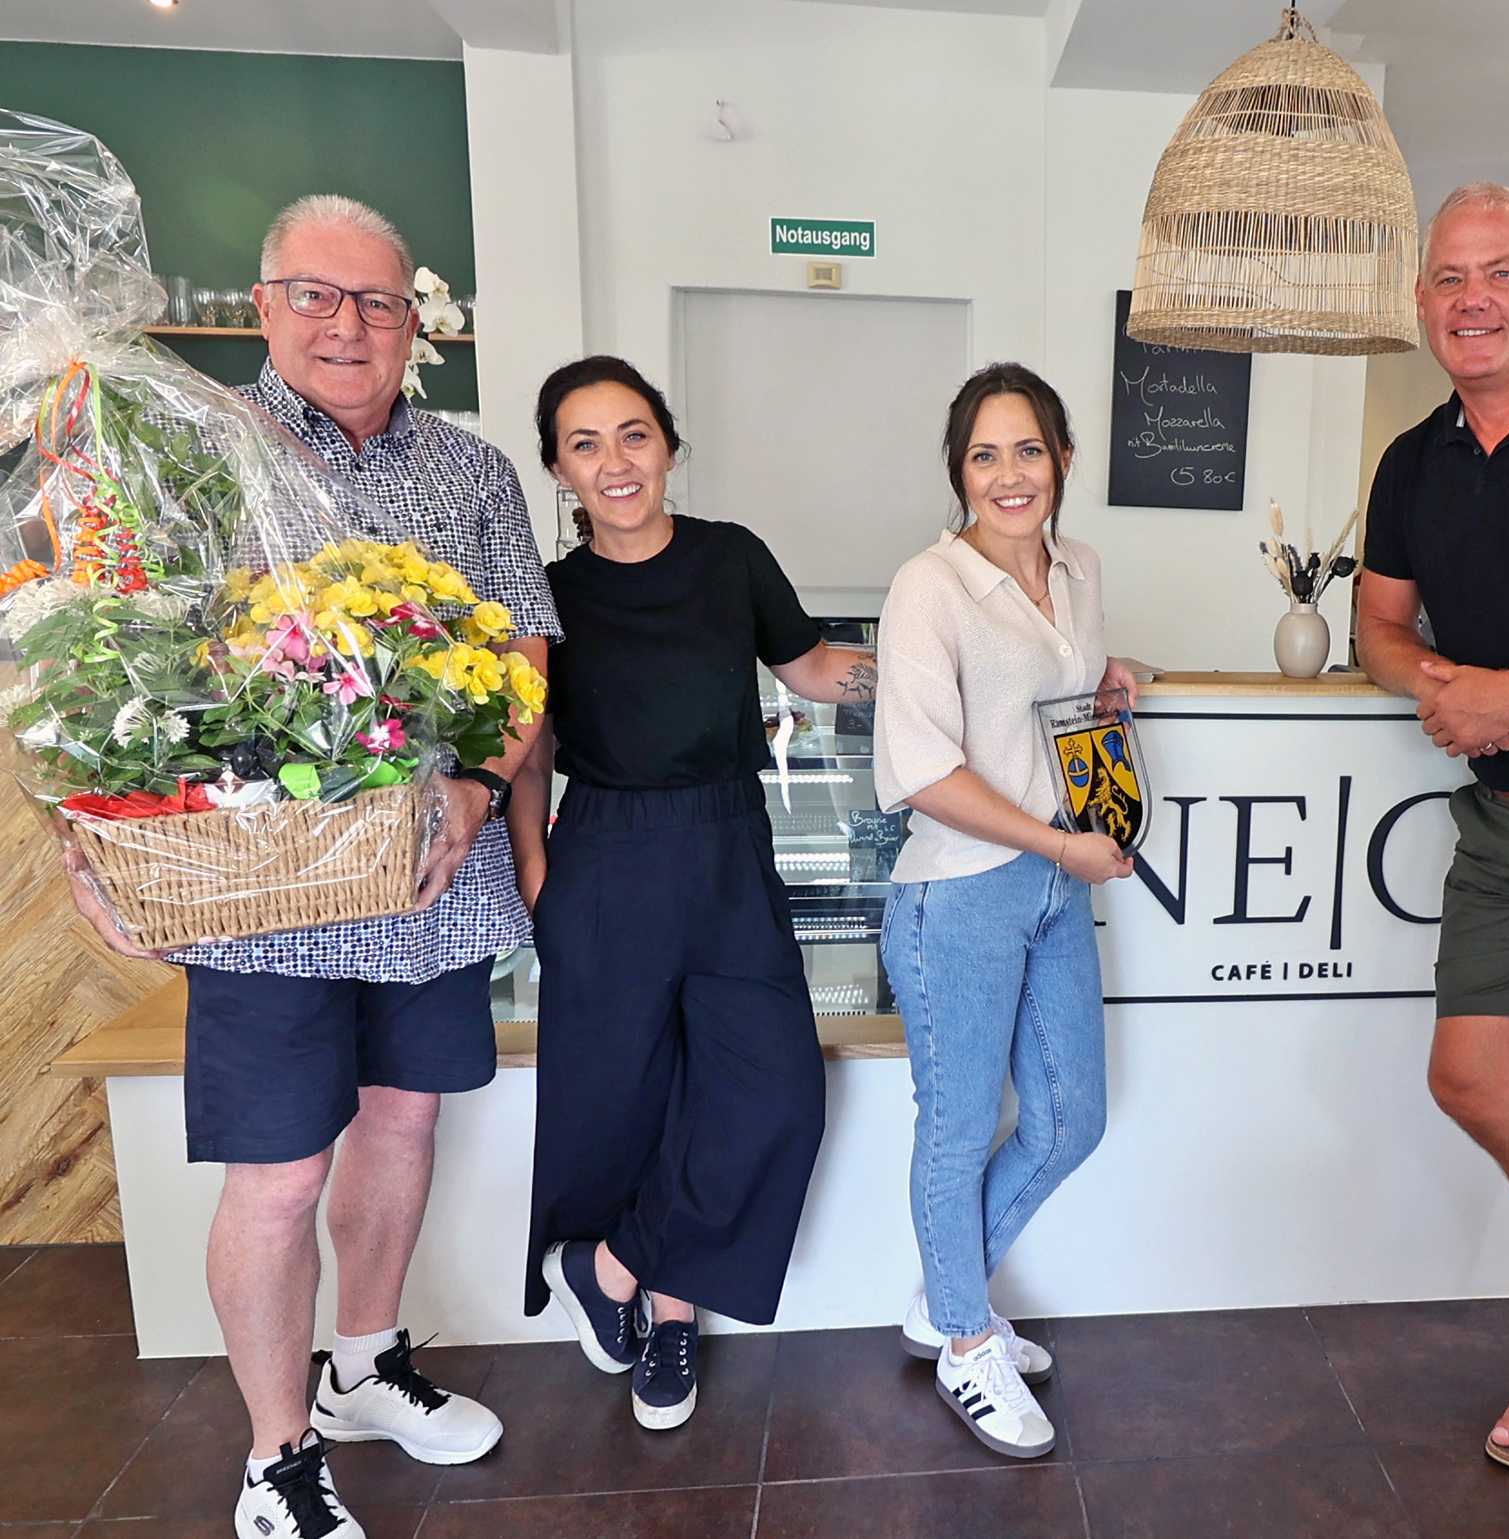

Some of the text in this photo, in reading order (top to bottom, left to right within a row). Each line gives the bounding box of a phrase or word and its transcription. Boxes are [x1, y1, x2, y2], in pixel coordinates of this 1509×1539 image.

[775, 224, 870, 251] Notausgang
[1120, 365, 1218, 407] Mortadella
[1144, 406, 1225, 441] Mozzarella
[1211, 960, 1272, 981] CAFÉ
[1299, 962, 1352, 979] DELI
